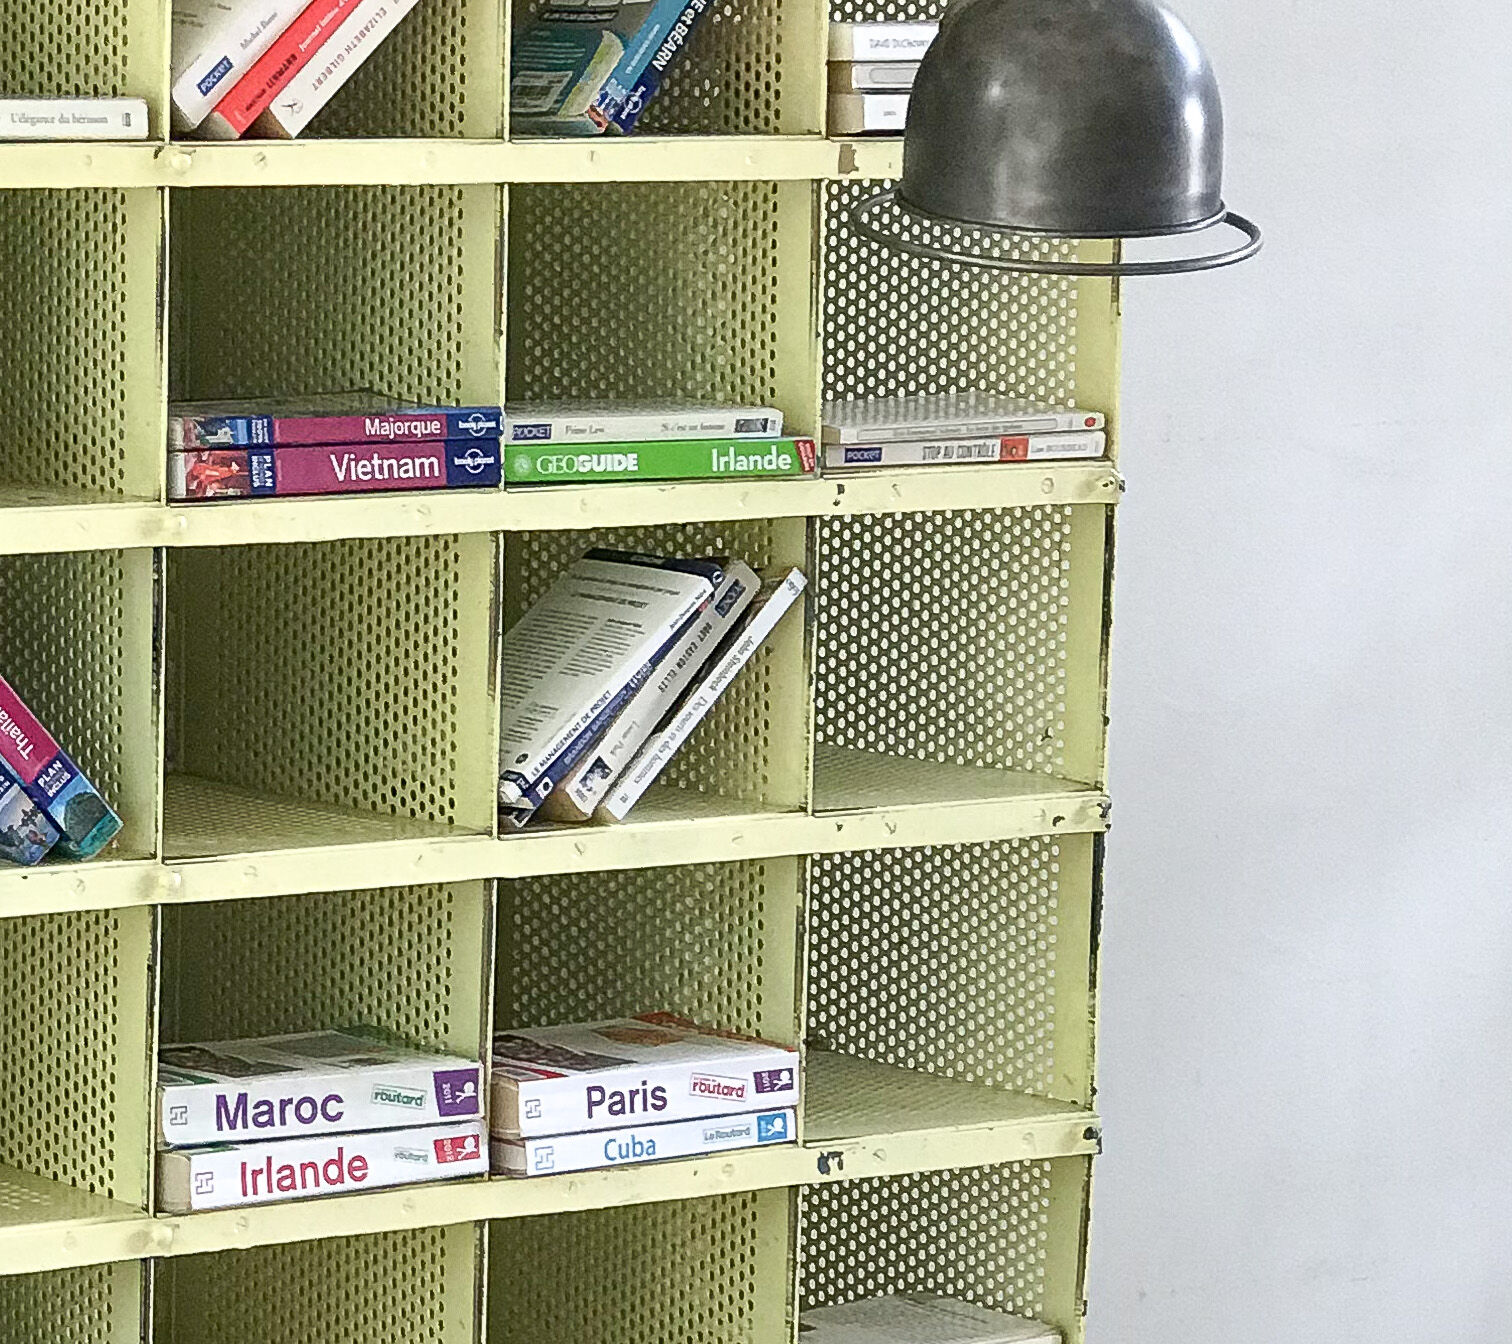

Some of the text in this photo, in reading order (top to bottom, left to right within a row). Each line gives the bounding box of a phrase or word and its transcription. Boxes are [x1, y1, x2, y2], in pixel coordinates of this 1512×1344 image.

[683, 7, 696, 24] et
[652, 17, 690, 72] BÉARN
[365, 418, 440, 439] Majorque
[330, 454, 439, 482] Vietnam
[536, 453, 638, 474] GEOGUIDE
[712, 445, 792, 472] Irlande
[847, 450, 880, 461] POCKET
[264, 455, 272, 487] PLAN
[538, 721, 585, 770] MANAGEMENT
[590, 690, 612, 715] PROJET
[38, 760, 63, 787] PLAN
[374, 1090, 423, 1107] routard
[443, 1083, 452, 1104] 2011
[586, 1080, 667, 1119] Paris
[692, 1080, 745, 1099] routard
[216, 1093, 344, 1132] Maroc
[604, 1134, 656, 1161] Cuba
[241, 1147, 368, 1197] Irlande
